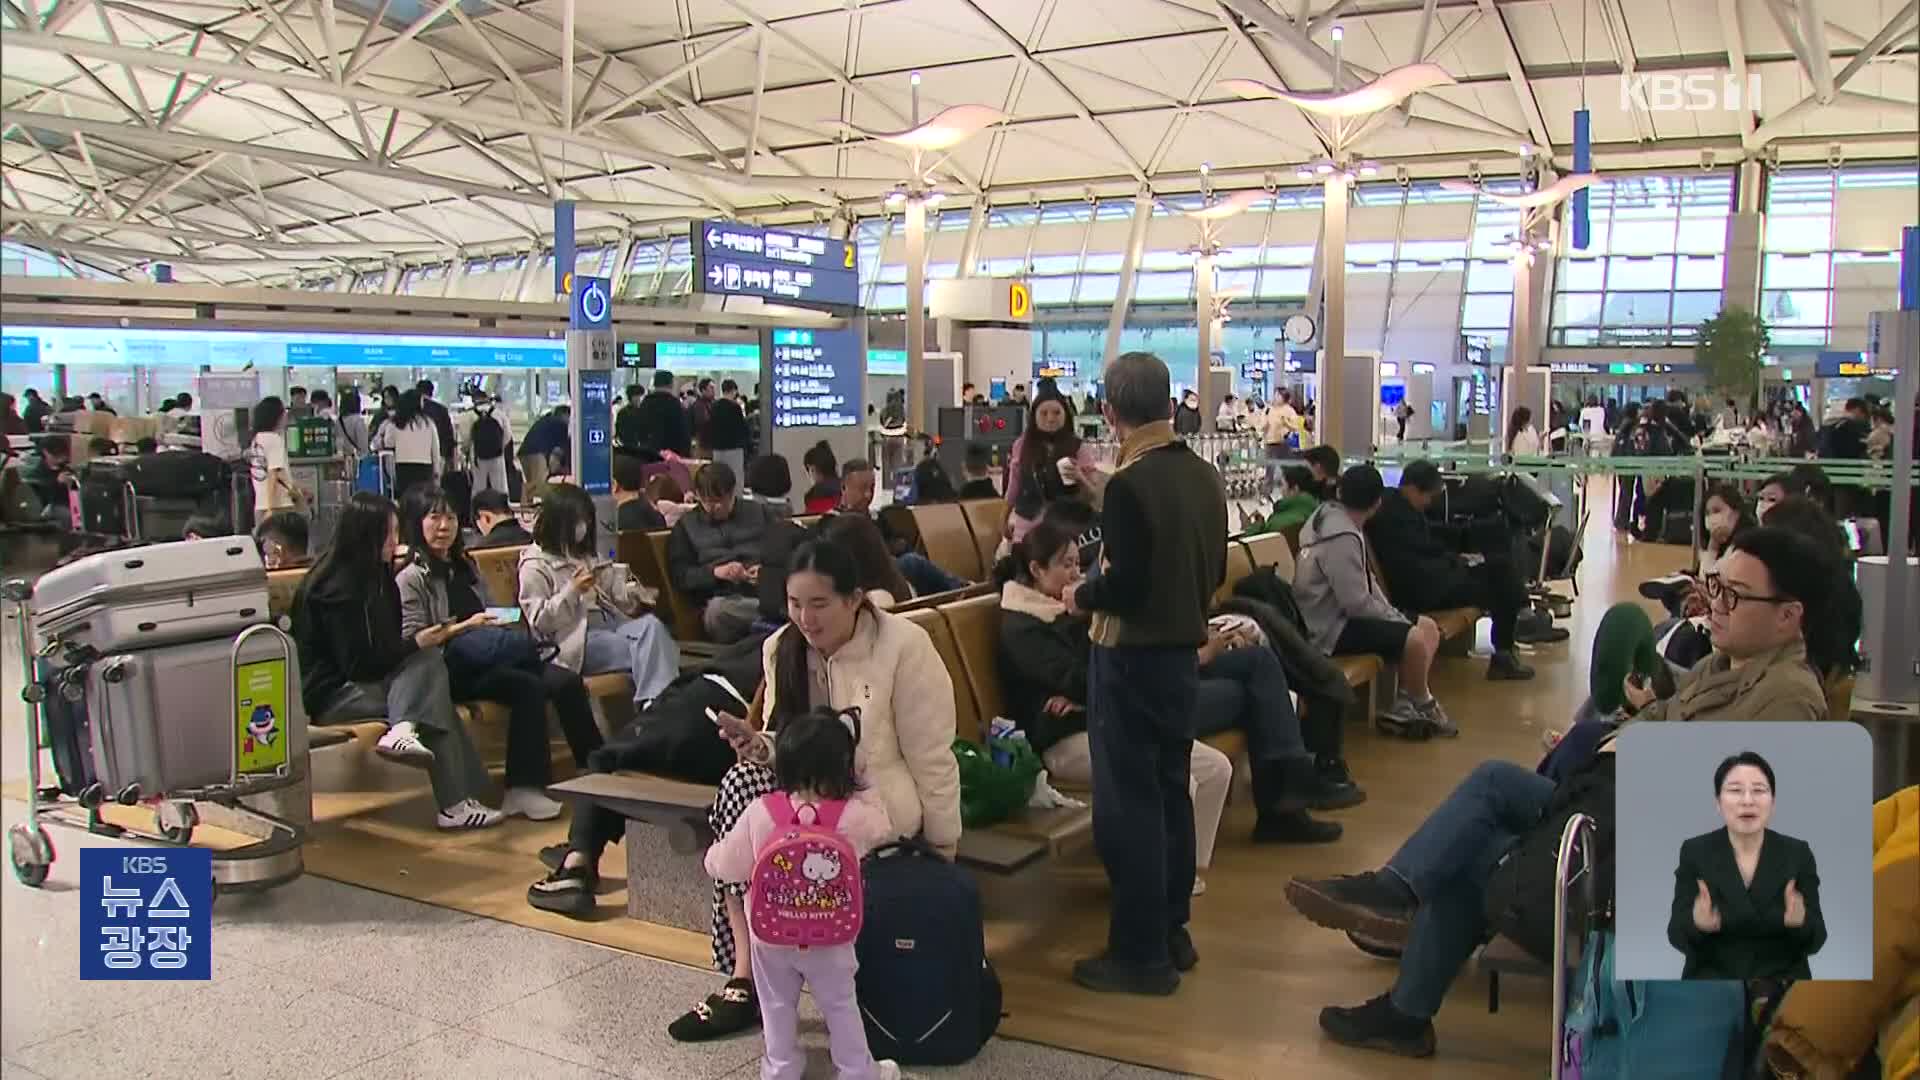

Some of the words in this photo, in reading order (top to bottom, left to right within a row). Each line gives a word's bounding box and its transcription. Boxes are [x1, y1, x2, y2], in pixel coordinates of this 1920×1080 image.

[843, 244, 855, 268] 2
[1010, 283, 1029, 318] D
[777, 909, 808, 919] HELLO
[809, 911, 836, 920] KITTY
